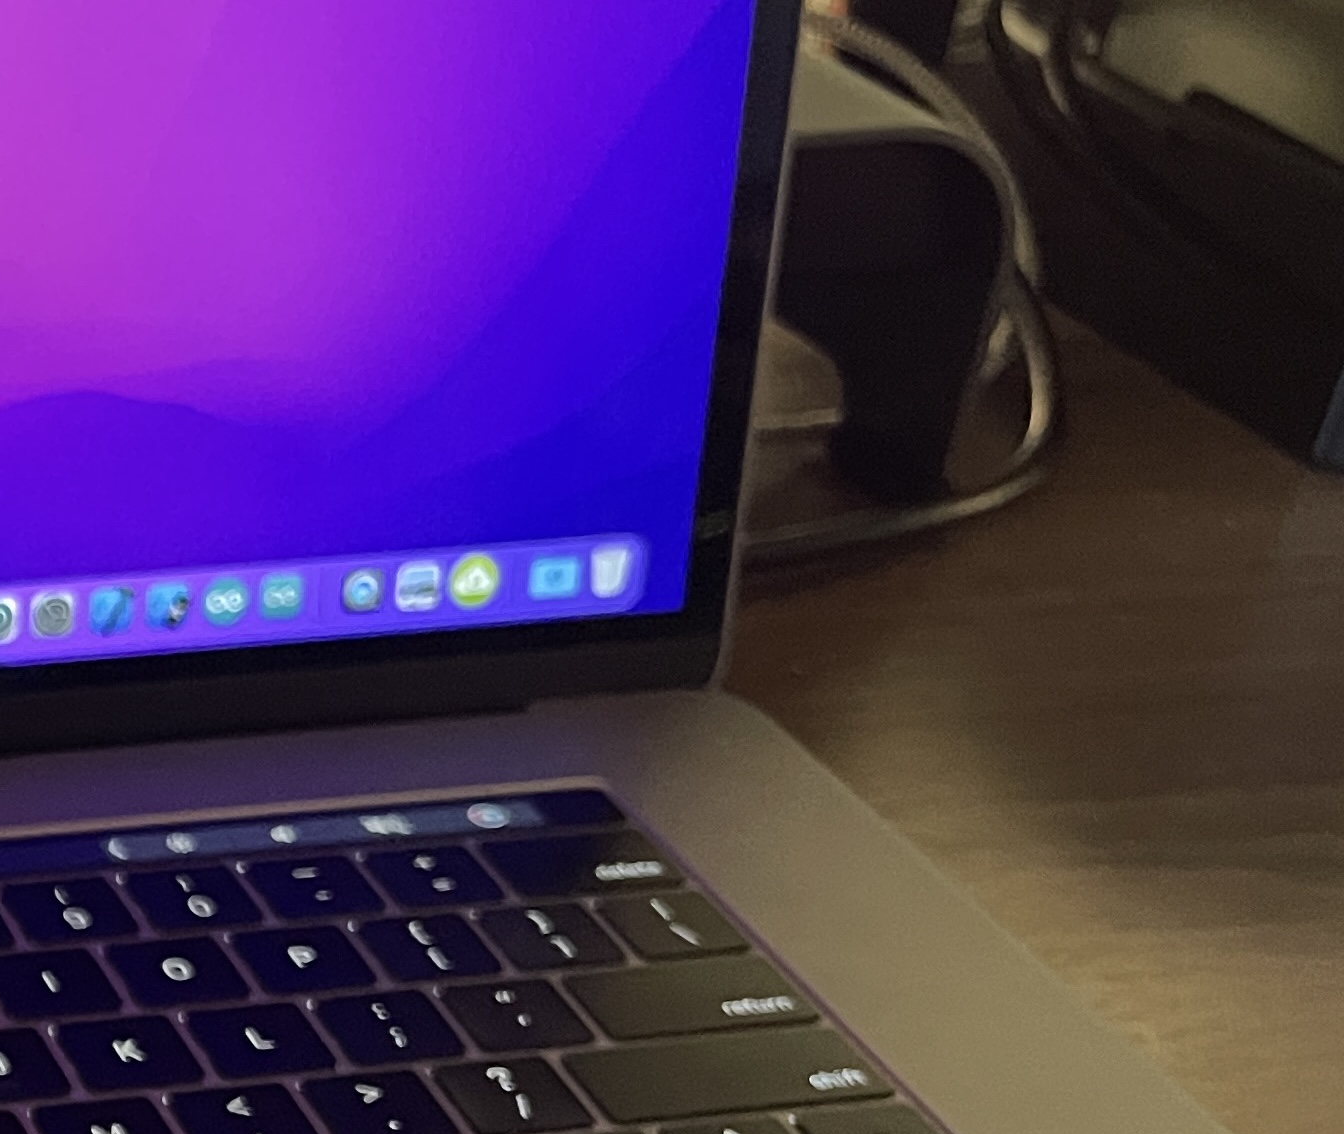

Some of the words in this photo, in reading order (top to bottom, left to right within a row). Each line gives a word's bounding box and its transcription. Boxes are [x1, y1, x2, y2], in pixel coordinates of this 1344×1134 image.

[187, 895, 215, 918] 0
[287, 945, 316, 969] P
[161, 957, 193, 982] O
[720, 995, 795, 1017] return
[111, 1038, 144, 1063] K
[244, 1027, 275, 1050] L
[808, 1067, 868, 1091] shift
